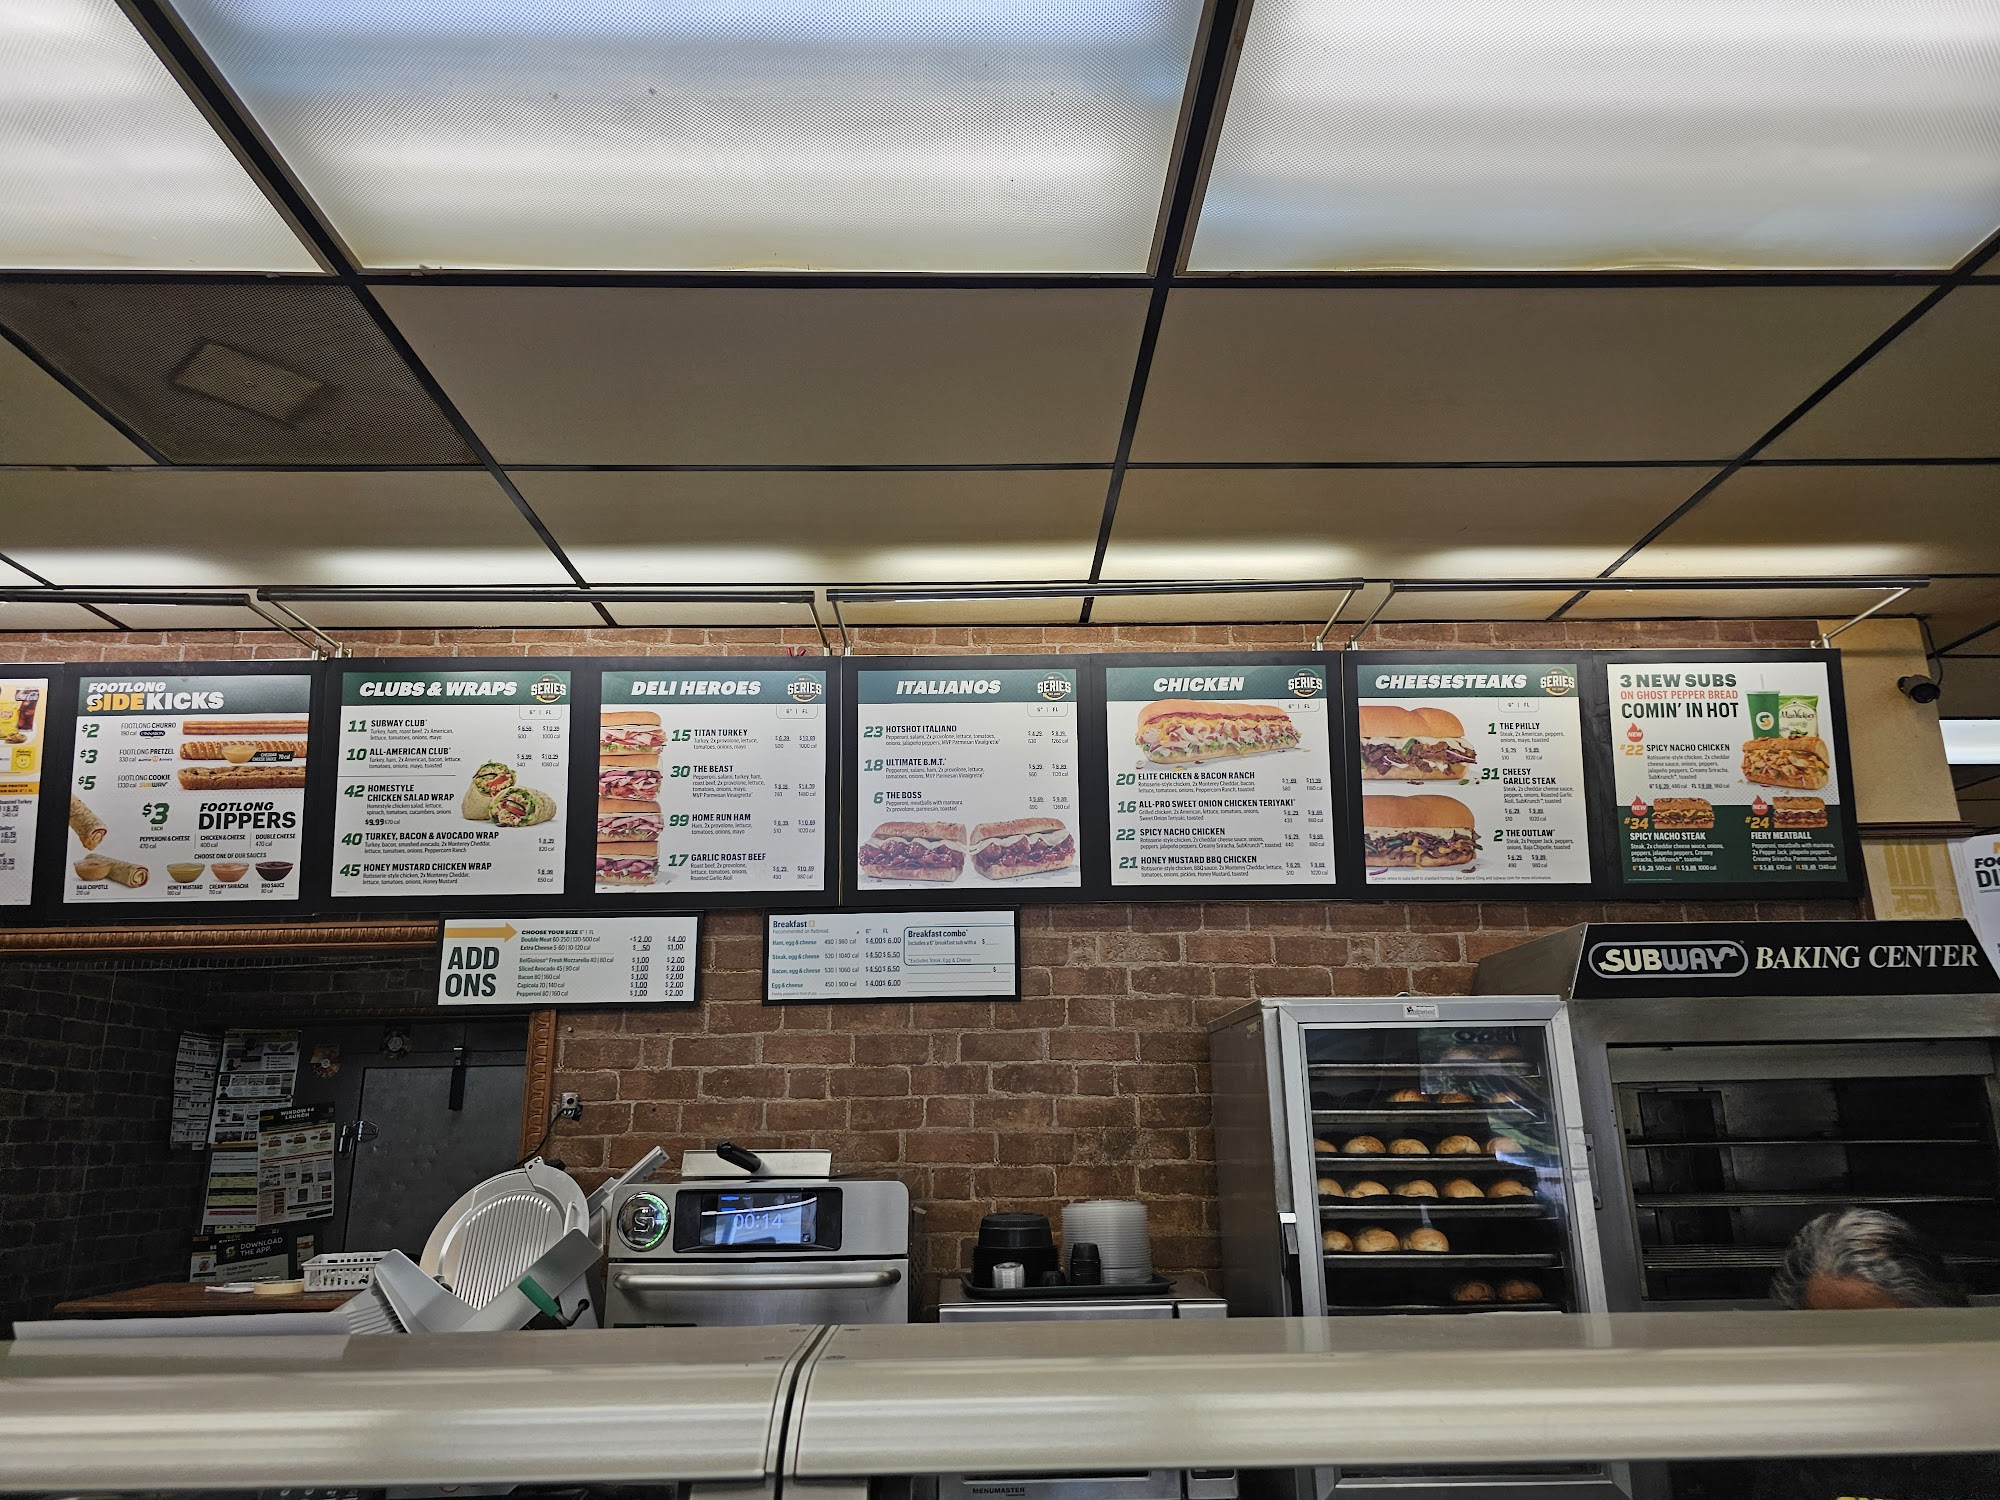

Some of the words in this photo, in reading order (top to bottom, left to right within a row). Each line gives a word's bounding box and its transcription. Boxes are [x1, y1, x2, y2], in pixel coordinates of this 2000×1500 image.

[1038, 679, 1071, 694] SERIES
[1154, 677, 1244, 692] CHICKEN
[1376, 675, 1527, 689] CHEESESTEAKS
[1541, 675, 1574, 690] SERIES
[1620, 675, 1631, 687] 3
[1636, 674, 1680, 687] NEW
[1686, 674, 1736, 687] SUBS
[87, 682, 166, 694] FOOTLONG
[360, 682, 425, 696] CLUBS
[427, 682, 442, 697] &
[447, 682, 517, 697] WRAPS
[531, 683, 566, 697] SERIES
[631, 681, 677, 695] DELI
[680, 681, 761, 695] HEROES
[897, 680, 1001, 695] ITALIANOS
[1621, 691, 1633, 699] ON
[1637, 691, 1667, 699] GHOST
[1671, 691, 1705, 699] PEPPER
[1708, 691, 1738, 699] BREAD
[1622, 703, 1681, 718] COMIN'
[1686, 703, 1702, 717] IN
[1707, 703, 1738, 717] HOT
[82, 724, 99, 738] $2
[348, 720, 367, 732] 11
[864, 726, 883, 737] 23
[886, 725, 921, 733] HOTSHOT
[923, 725, 956, 733] ITALIANO
[1488, 723, 1496, 734] 1
[1500, 722, 1513, 730] THE
[1516, 722, 1539, 730] PHILLY
[672, 730, 691, 741] 15
[695, 729, 716, 737] TITAN
[719, 729, 747, 737] TURKEY
[1627, 731, 1643, 739] NEW
[80, 750, 98, 763] $3
[120, 748, 149, 756] FOOTLONG
[347, 749, 367, 760] 10
[1620, 744, 1644, 756] #22
[1647, 744, 1667, 752] SPICY
[1670, 744, 1695, 752] NACHO
[670, 766, 690, 777] 30
[694, 765, 707, 773] THE
[710, 765, 732, 773] BEAST
[864, 759, 883, 771] 18
[887, 758, 921, 766] ULTIMATE
[118, 774, 147, 782] FOOTLONG
[1116, 774, 1135, 785] 20
[1160, 772, 1192, 780] CHICKEN
[1194, 772, 1199, 780] &
[1201, 772, 1226, 780] BACON
[1481, 768, 1499, 779] 31
[1503, 768, 1530, 776] CHEESY
[78, 776, 96, 790] $5
[1504, 777, 1530, 785] GARLIC
[1532, 777, 1556, 785] STEAK
[345, 785, 365, 797] 42
[431, 793, 454, 801] WRAP
[874, 792, 884, 804] 6
[886, 791, 900, 799] THE
[902, 791, 921, 799] BOSS
[200, 802, 273, 812] FOOTLONG
[1118, 801, 1136, 813] 16
[1139, 800, 1170, 808] ALL-PRO
[1172, 800, 1196, 808] SWEET
[1225, 799, 1257, 807] CHICKEN
[1630, 804, 1646, 812] NEW
[1751, 803, 1769, 811] NEW
[142, 803, 169, 824] $3
[670, 815, 689, 826] 99
[734, 813, 750, 821] HAM
[199, 811, 295, 830] DIPPERS
[1624, 818, 1648, 829] #34
[1745, 817, 1769, 828] #24
[342, 833, 363, 845] 40
[400, 832, 427, 840] BACON
[1116, 829, 1135, 840] 22
[1140, 828, 1162, 836] SPICY
[1164, 828, 1190, 836] NACHO
[1494, 830, 1503, 841] 2
[1506, 829, 1520, 837] THE
[1654, 832, 1680, 840] NACHO
[1681, 832, 1706, 840] STEAK
[668, 854, 688, 866] 17
[721, 853, 746, 861] ROAST
[1119, 857, 1138, 868] 21
[1168, 856, 1204, 864] MUSTARD
[1207, 856, 1221, 864] BBQ
[340, 864, 361, 876] 45
[448, 947, 499, 969] ADD
[1598, 945, 1739, 973] SUBWAY
[1755, 946, 1861, 969] BAKING
[1869, 945, 1979, 968] CENTER
[446, 974, 496, 997] ONS
[733, 1212, 782, 1228] 00:14
[240, 1237, 283, 1250] DOWNLOAD
